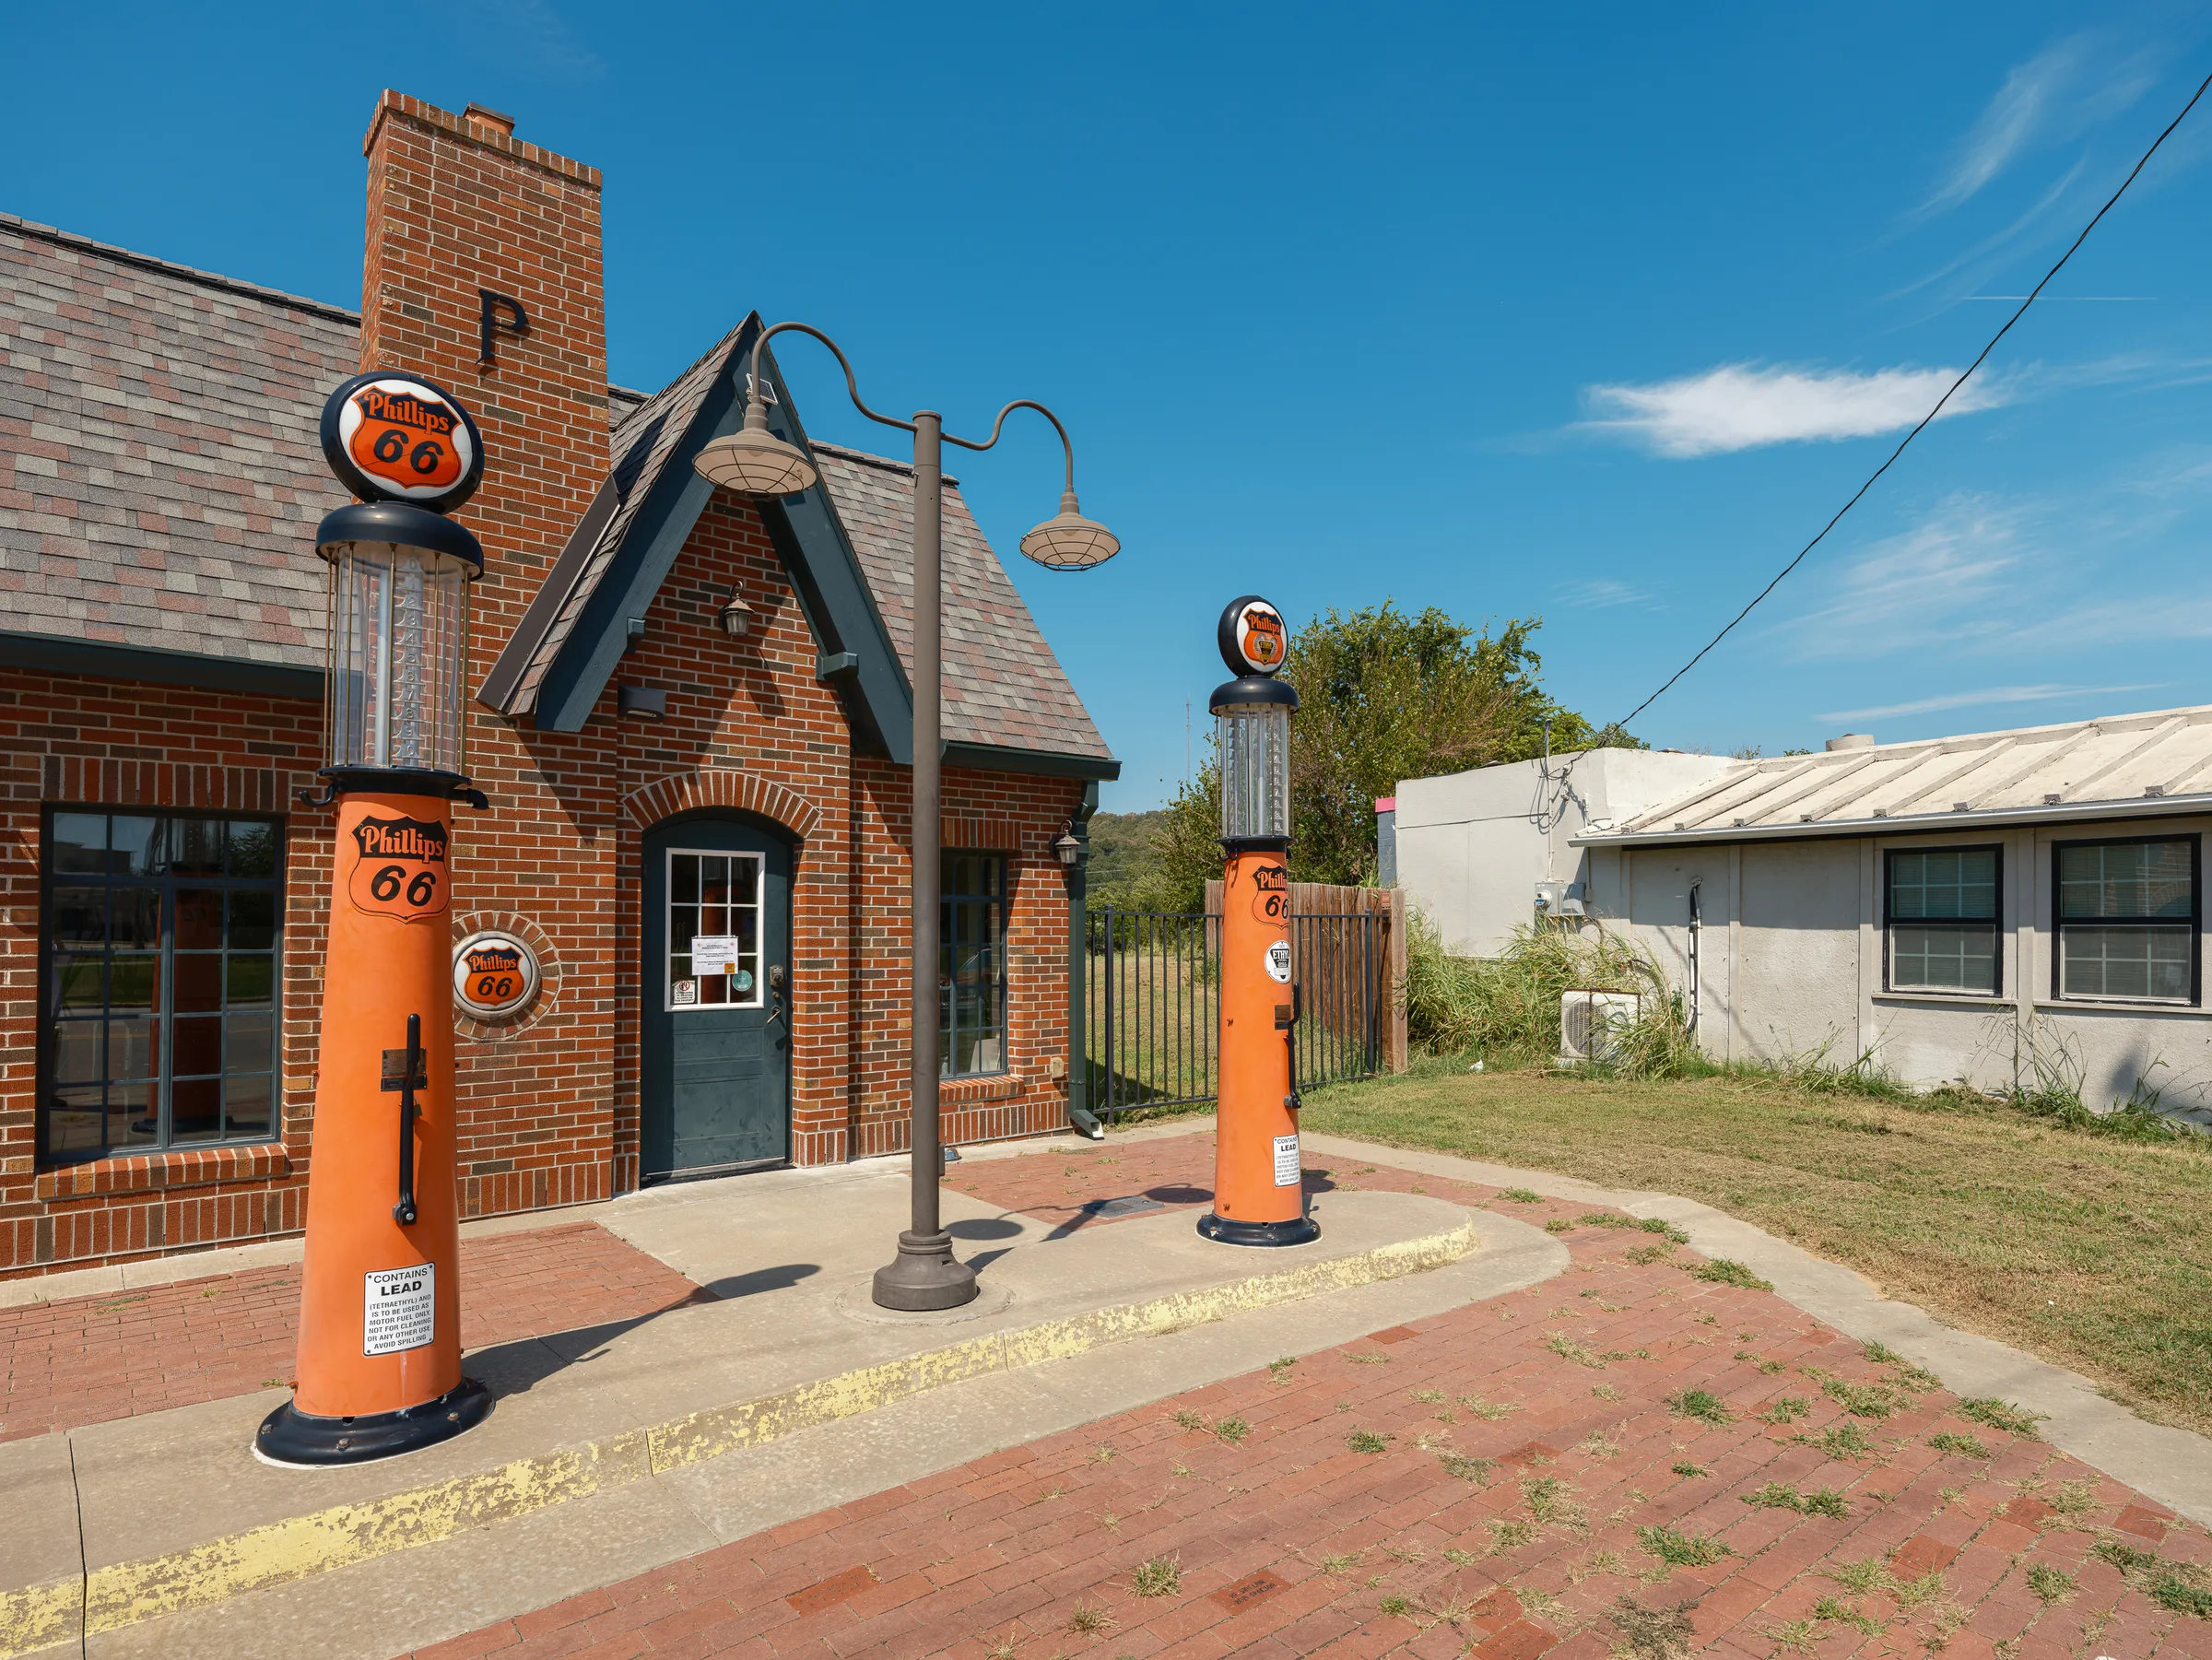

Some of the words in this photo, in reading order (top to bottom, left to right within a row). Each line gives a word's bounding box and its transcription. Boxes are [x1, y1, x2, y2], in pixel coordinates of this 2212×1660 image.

[476, 288, 527, 365] P
[364, 392, 450, 435] Phillips
[373, 429, 444, 475] 66
[1248, 613, 1280, 636] Phillips
[406, 632, 416, 644] 4
[359, 825, 443, 863] Phillips
[371, 865, 437, 907] 66
[1265, 895, 1288, 919] 66
[469, 955, 516, 973] Phillips
[477, 975, 512, 997] 66
[373, 1267, 428, 1283] CONTAINS
[381, 1280, 422, 1296] LEAD
[370, 1298, 418, 1311] (TETRAETHYL)
[403, 1304, 419, 1313] USED
[369, 1317, 395, 1325] MOTOR
[400, 1317, 431, 1329] CLEANING
[395, 1328, 418, 1338] OTHER
[374, 1341, 396, 1349] AVOID
[397, 1335, 427, 1346] SPILLING
